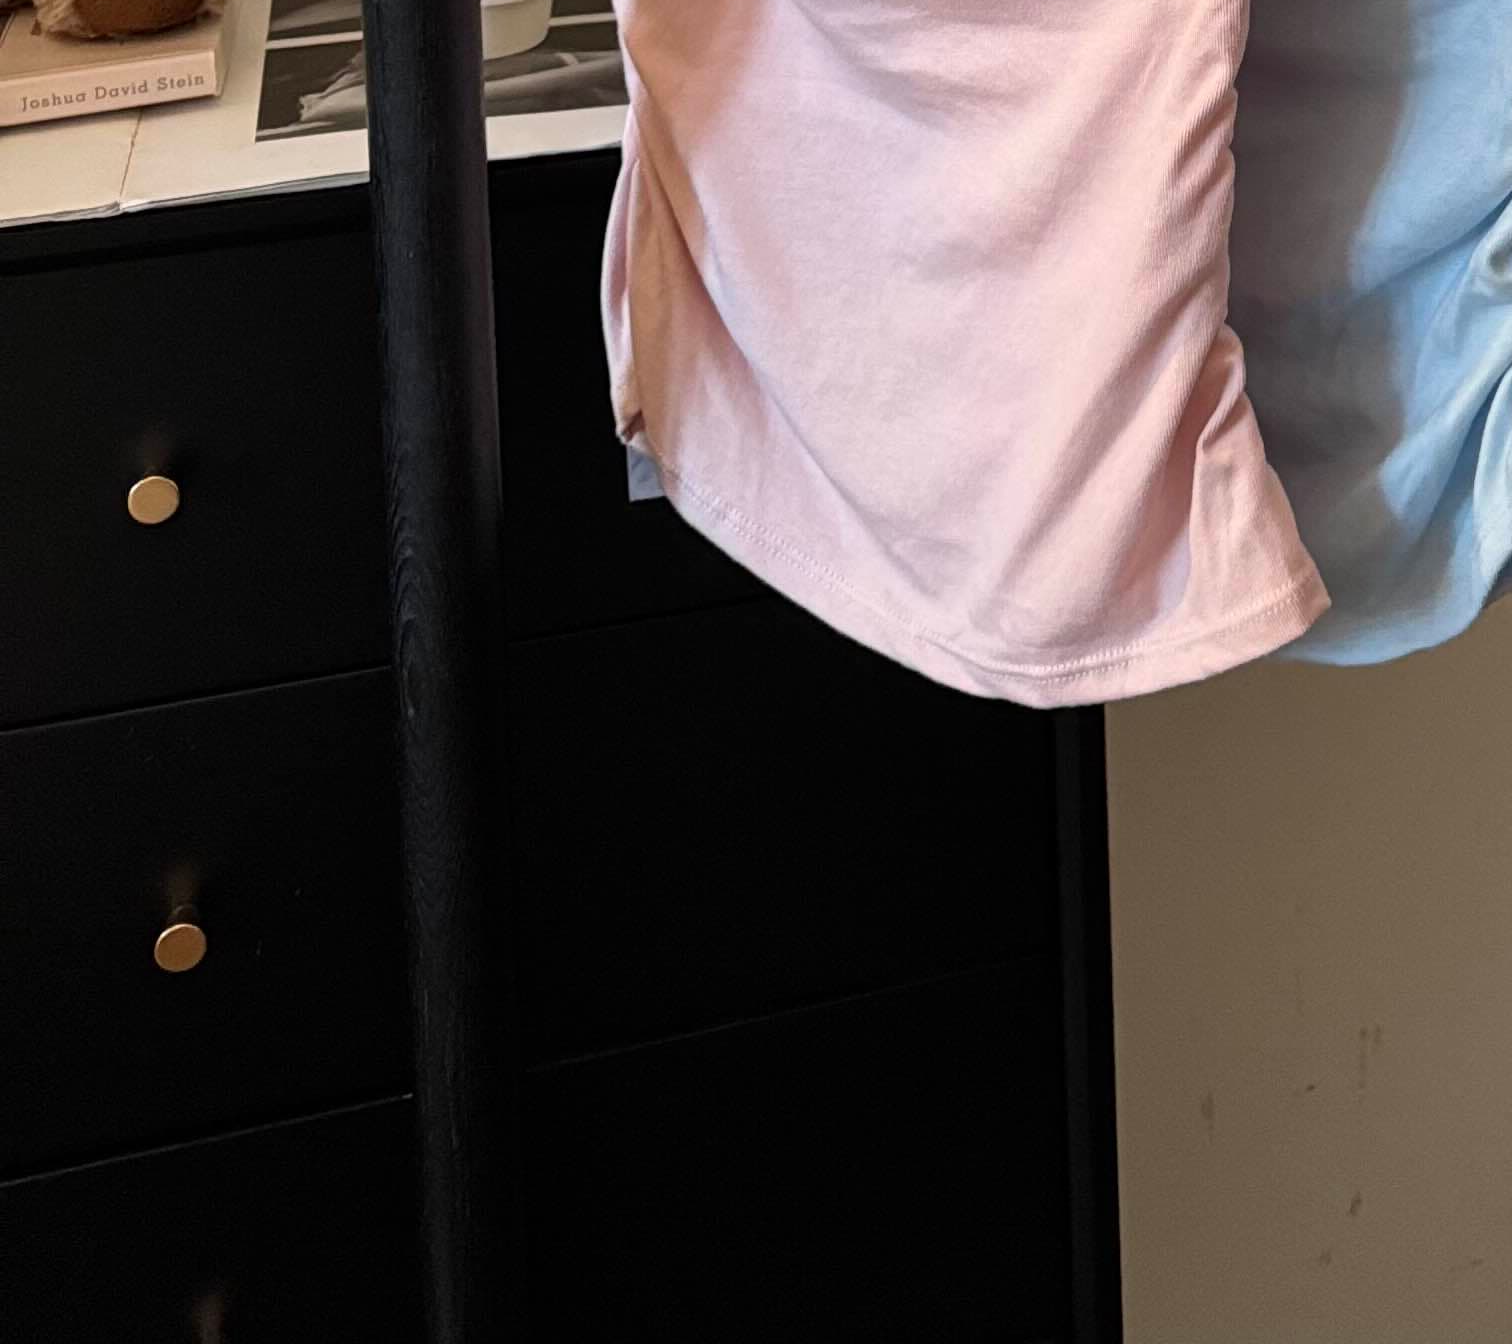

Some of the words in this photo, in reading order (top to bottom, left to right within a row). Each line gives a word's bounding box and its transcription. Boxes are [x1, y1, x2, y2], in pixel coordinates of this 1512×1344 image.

[20, 91, 87, 113] Joshua
[94, 80, 149, 100] David
[156, 73, 205, 92] Stein
